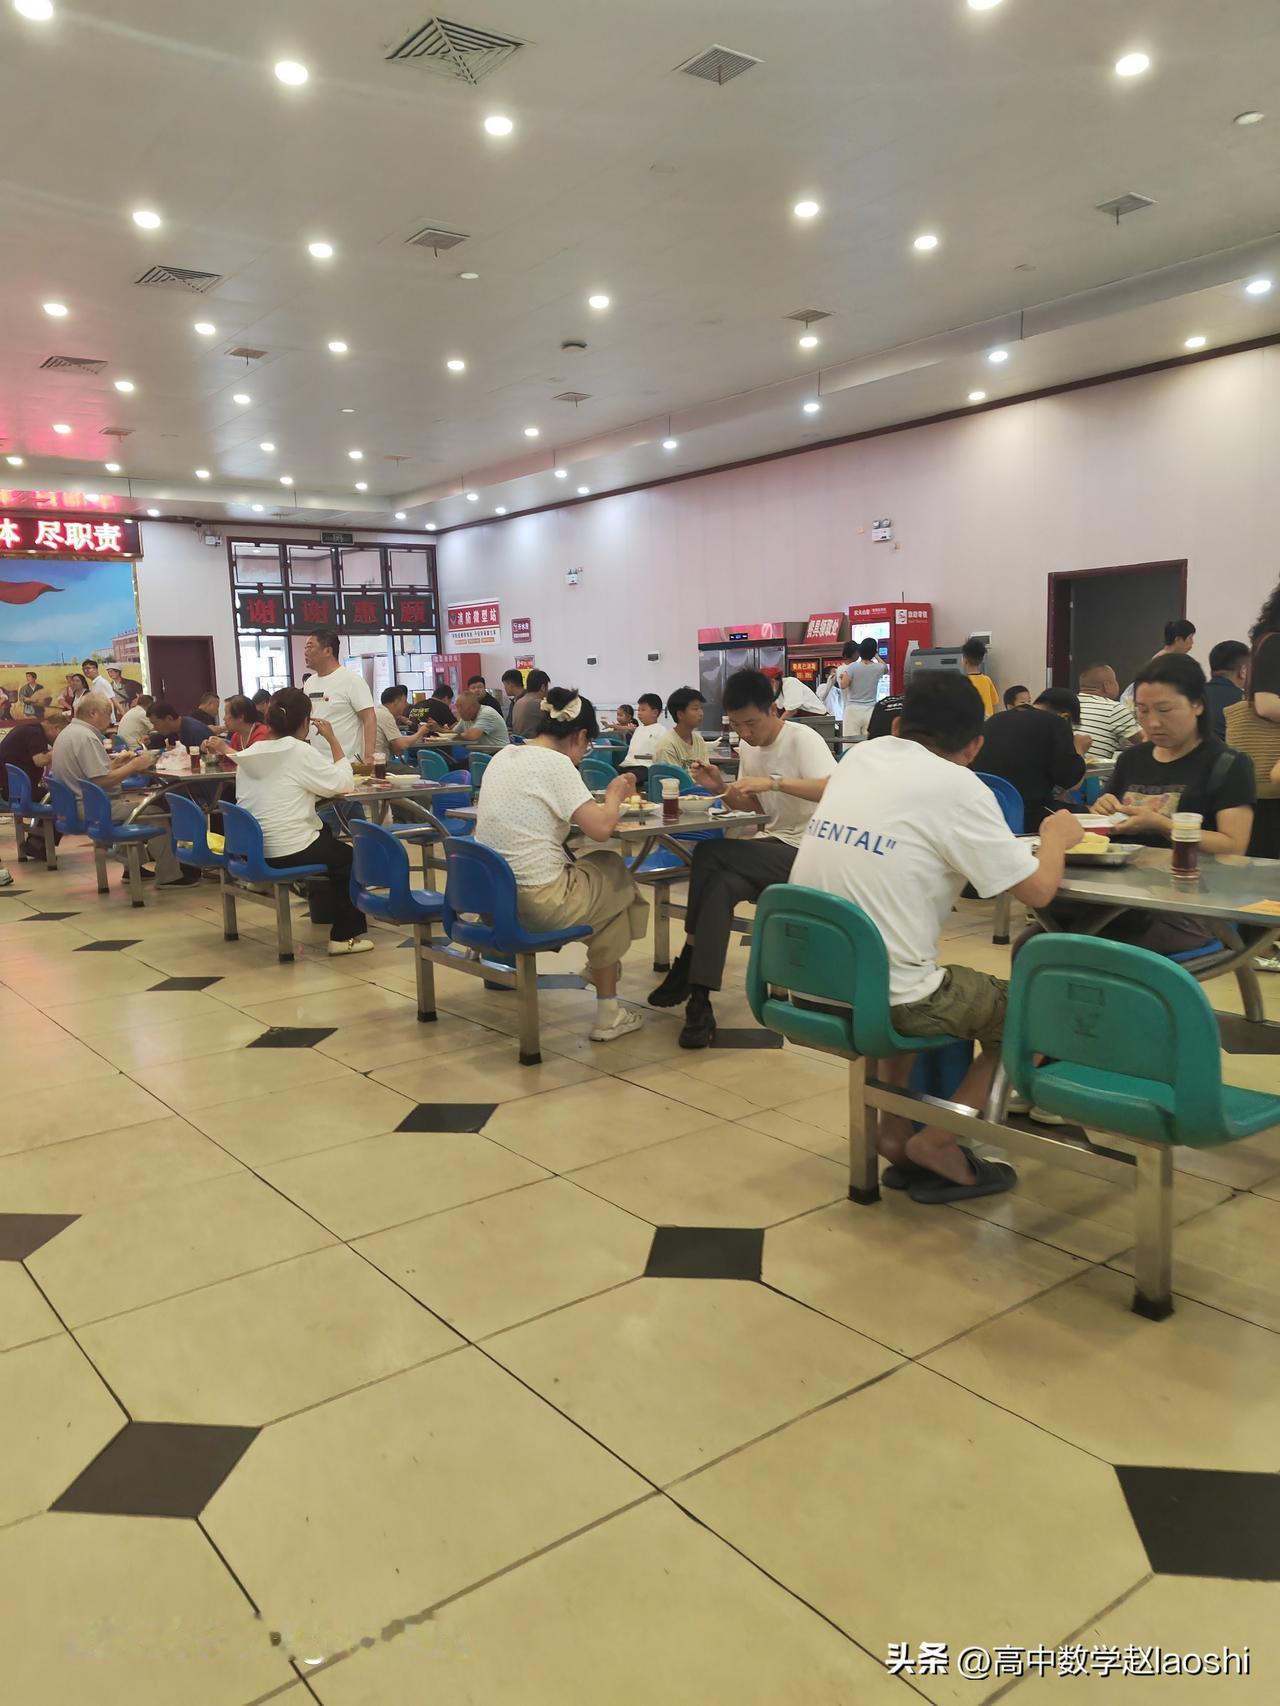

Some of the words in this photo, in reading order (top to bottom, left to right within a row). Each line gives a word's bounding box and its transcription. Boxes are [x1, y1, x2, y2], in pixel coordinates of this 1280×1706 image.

[34, 520, 122, 553] 尽职责
[457, 608, 497, 625] 消防微型站
[806, 619, 840, 638] 餐具领取处
